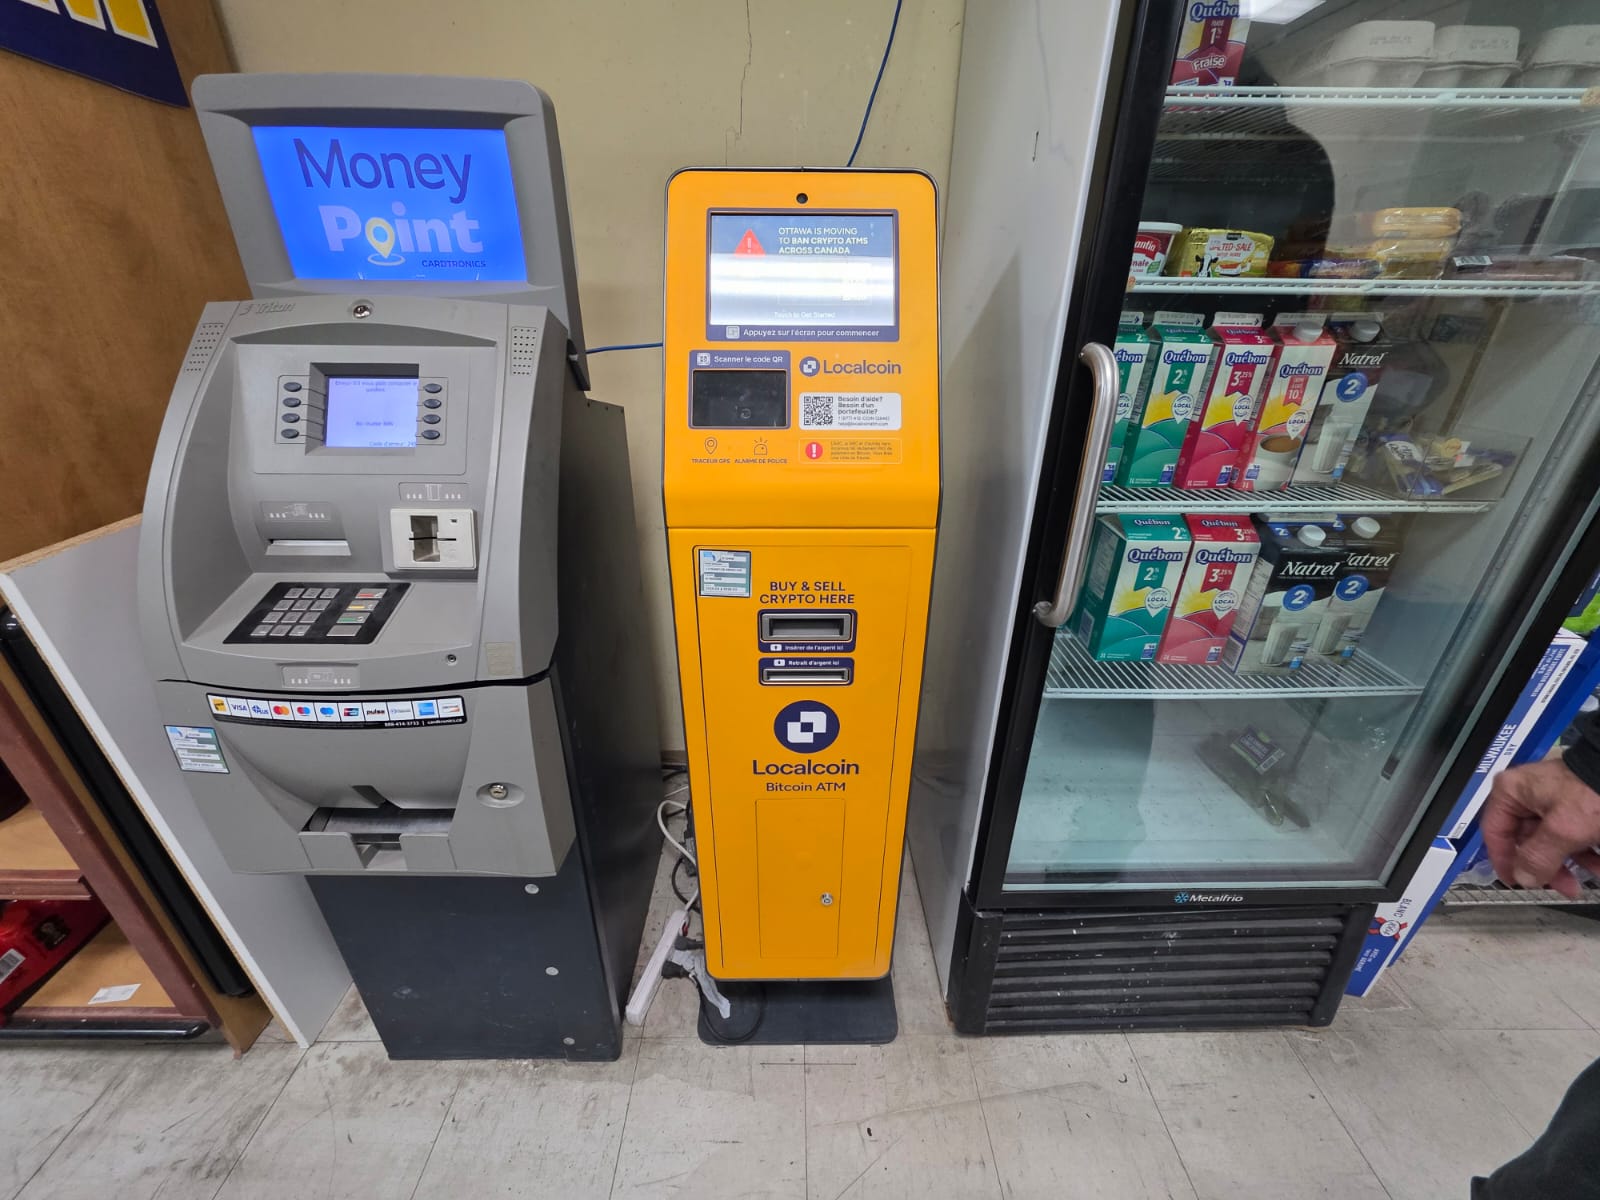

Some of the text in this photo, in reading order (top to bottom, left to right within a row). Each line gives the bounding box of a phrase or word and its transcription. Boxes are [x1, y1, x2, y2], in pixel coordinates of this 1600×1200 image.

[1191, 1, 1238, 21] Québo
[1193, 56, 1225, 70] Fraise
[293, 138, 472, 204] Money
[318, 201, 484, 265] Point
[778, 227, 858, 235] OTTAWA IS MOVING
[779, 237, 868, 245] TO BAN CRYPTO ATMS
[778, 246, 850, 254] ACROSS CANADA
[421, 260, 486, 268] CARDTRONICS
[743, 328, 776, 337] Appuyez
[789, 328, 816, 336] l'écran
[713, 355, 783, 363] Scanner le code QR
[1115, 349, 1143, 361] ébon
[1164, 348, 1206, 363] Québon
[1226, 351, 1268, 365] Québon
[1338, 352, 1384, 365] Natrel
[823, 359, 901, 374] Localcoin
[1280, 362, 1323, 376] Québon
[1202, 519, 1238, 527] Québon
[1128, 547, 1183, 562] Québon
[1196, 548, 1252, 564] Québon
[1280, 561, 1340, 575] Natrel
[770, 581, 845, 591] BUY & SELL
[760, 594, 855, 604] CRYPTO HERE
[231, 703, 247, 711] VISA
[1475, 724, 1518, 773] MILWAUKEE
[752, 759, 860, 775] Localcoin
[766, 782, 846, 792] Bitcoin ATM
[1189, 894, 1244, 902] Metalfrio
[1393, 898, 1412, 918] BLANC
